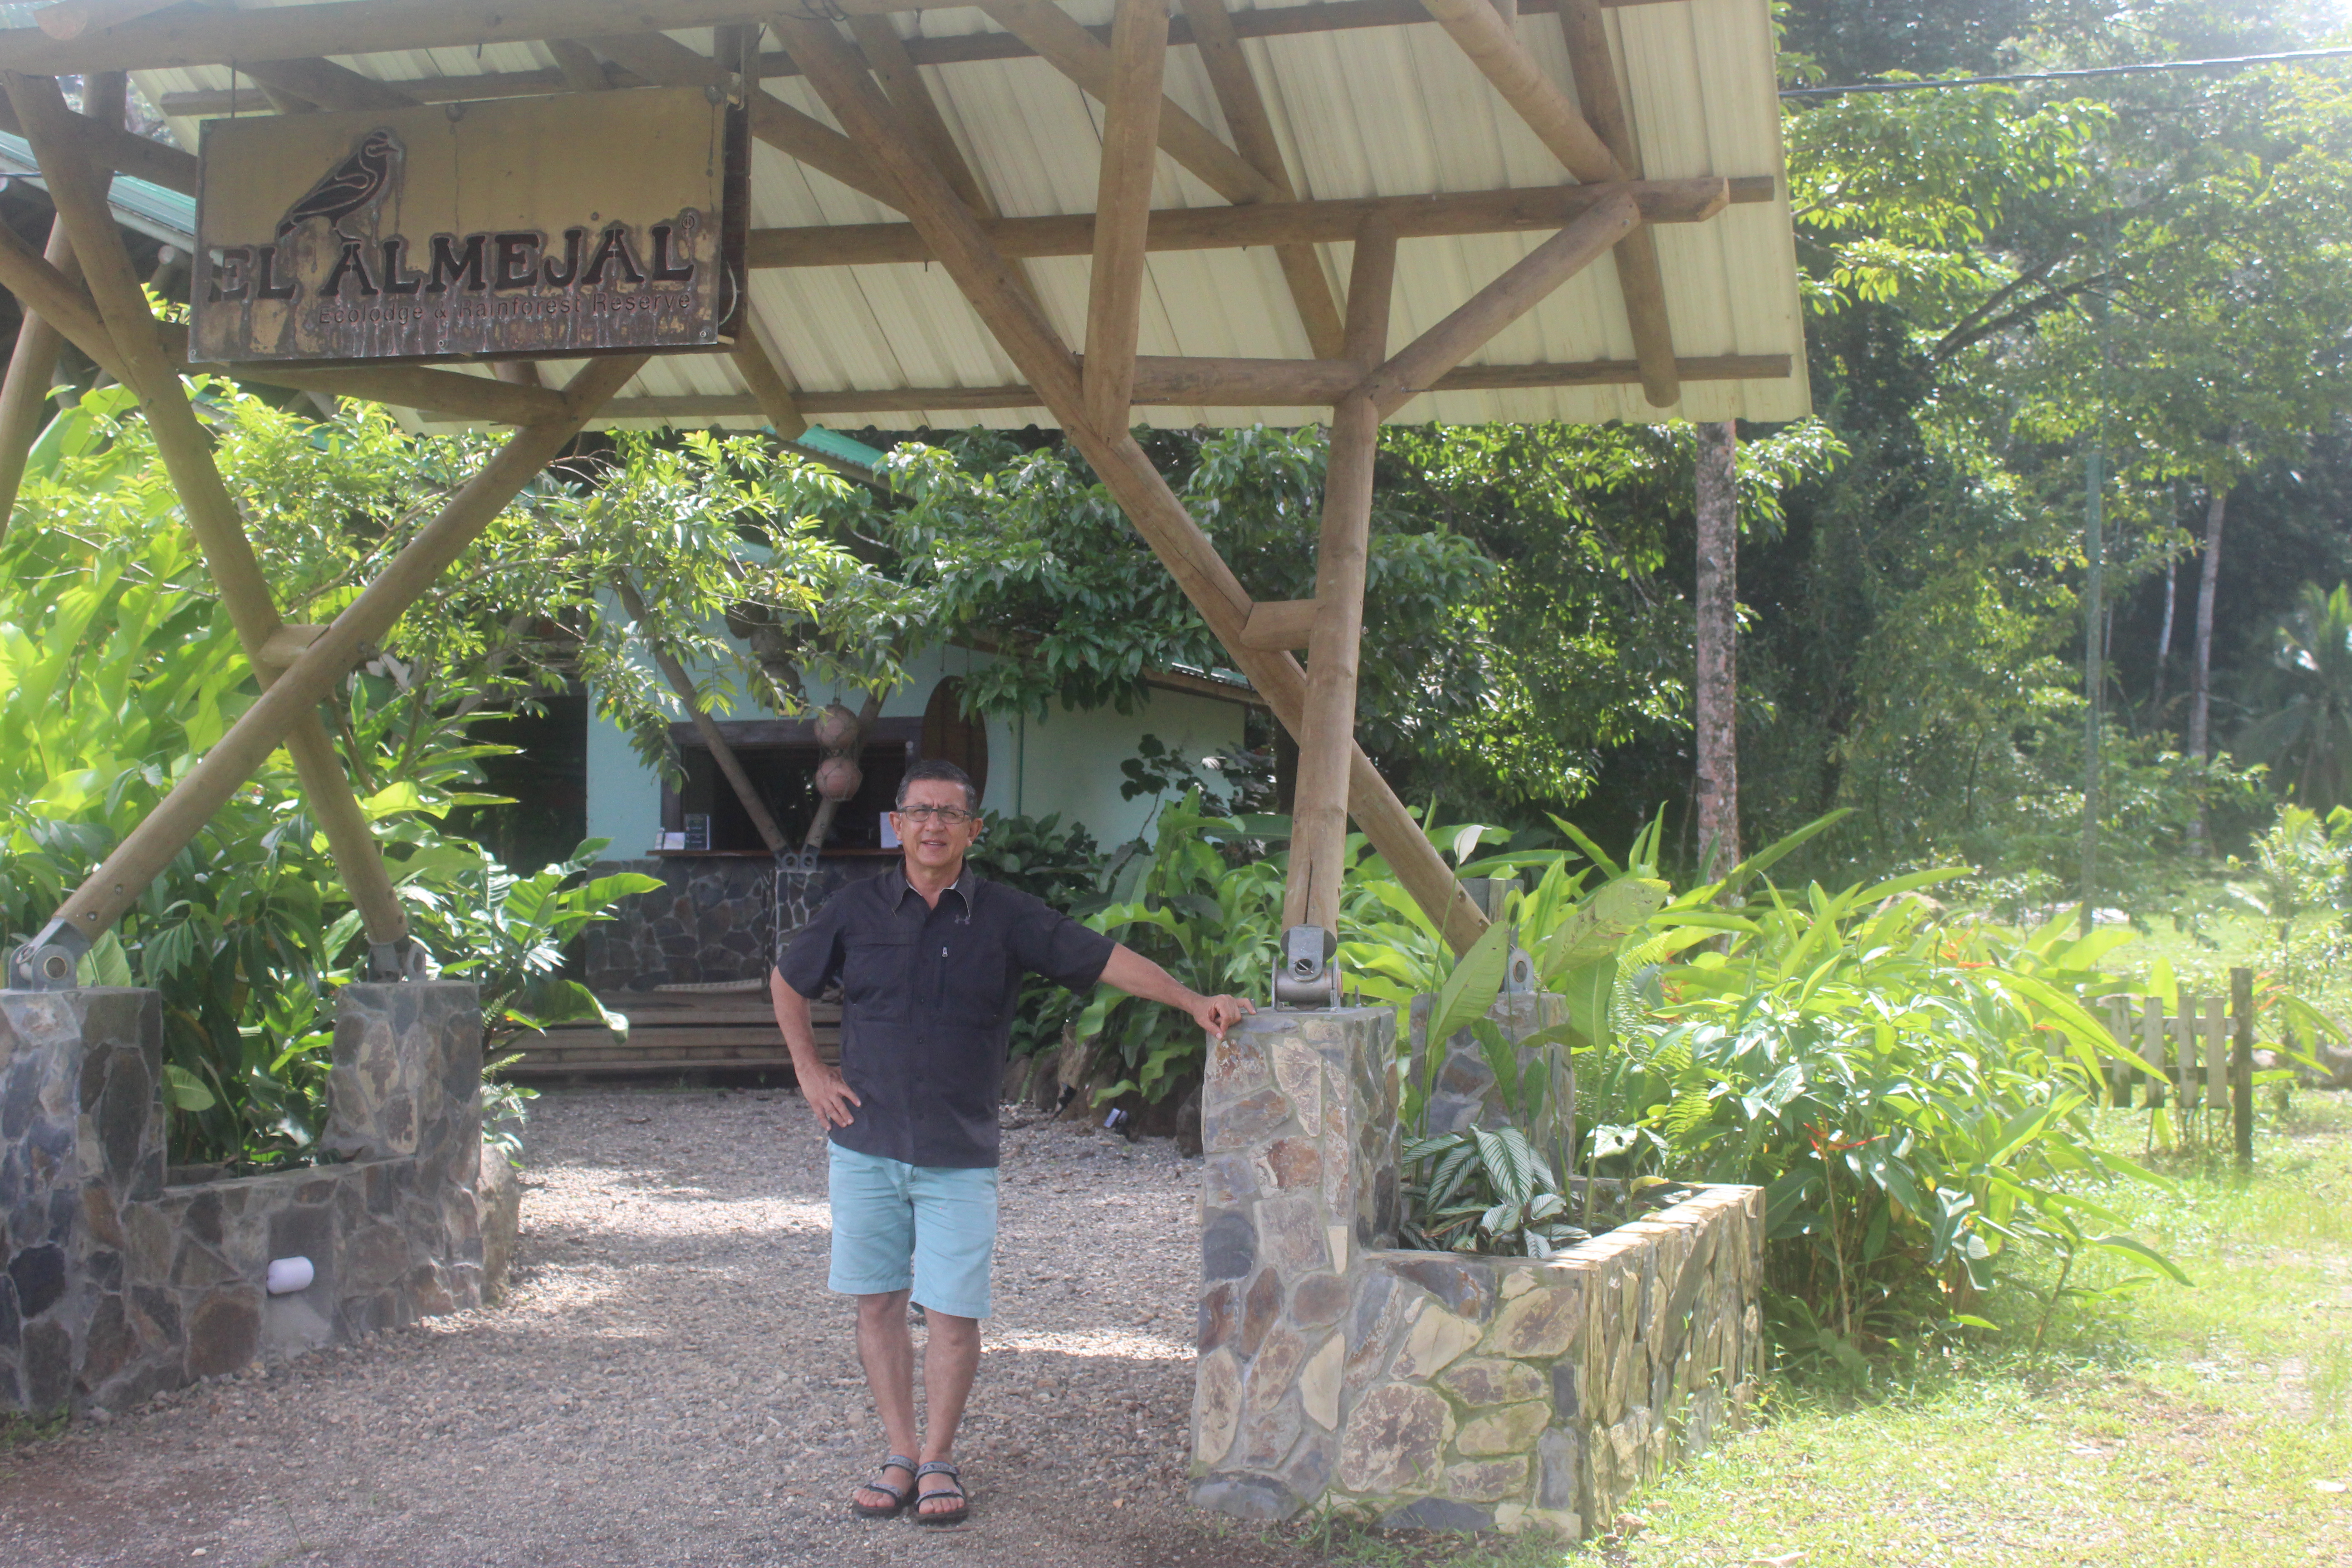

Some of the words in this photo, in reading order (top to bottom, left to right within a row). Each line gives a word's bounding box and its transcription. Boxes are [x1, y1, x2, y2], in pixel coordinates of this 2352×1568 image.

[208, 246, 297, 303] EL
[318, 226, 694, 296] ALMEJAL
[319, 304, 422, 325] Ecolodge
[434, 301, 447, 318] &
[459, 295, 581, 317] Rainforest
[592, 291, 691, 312] Reserve
